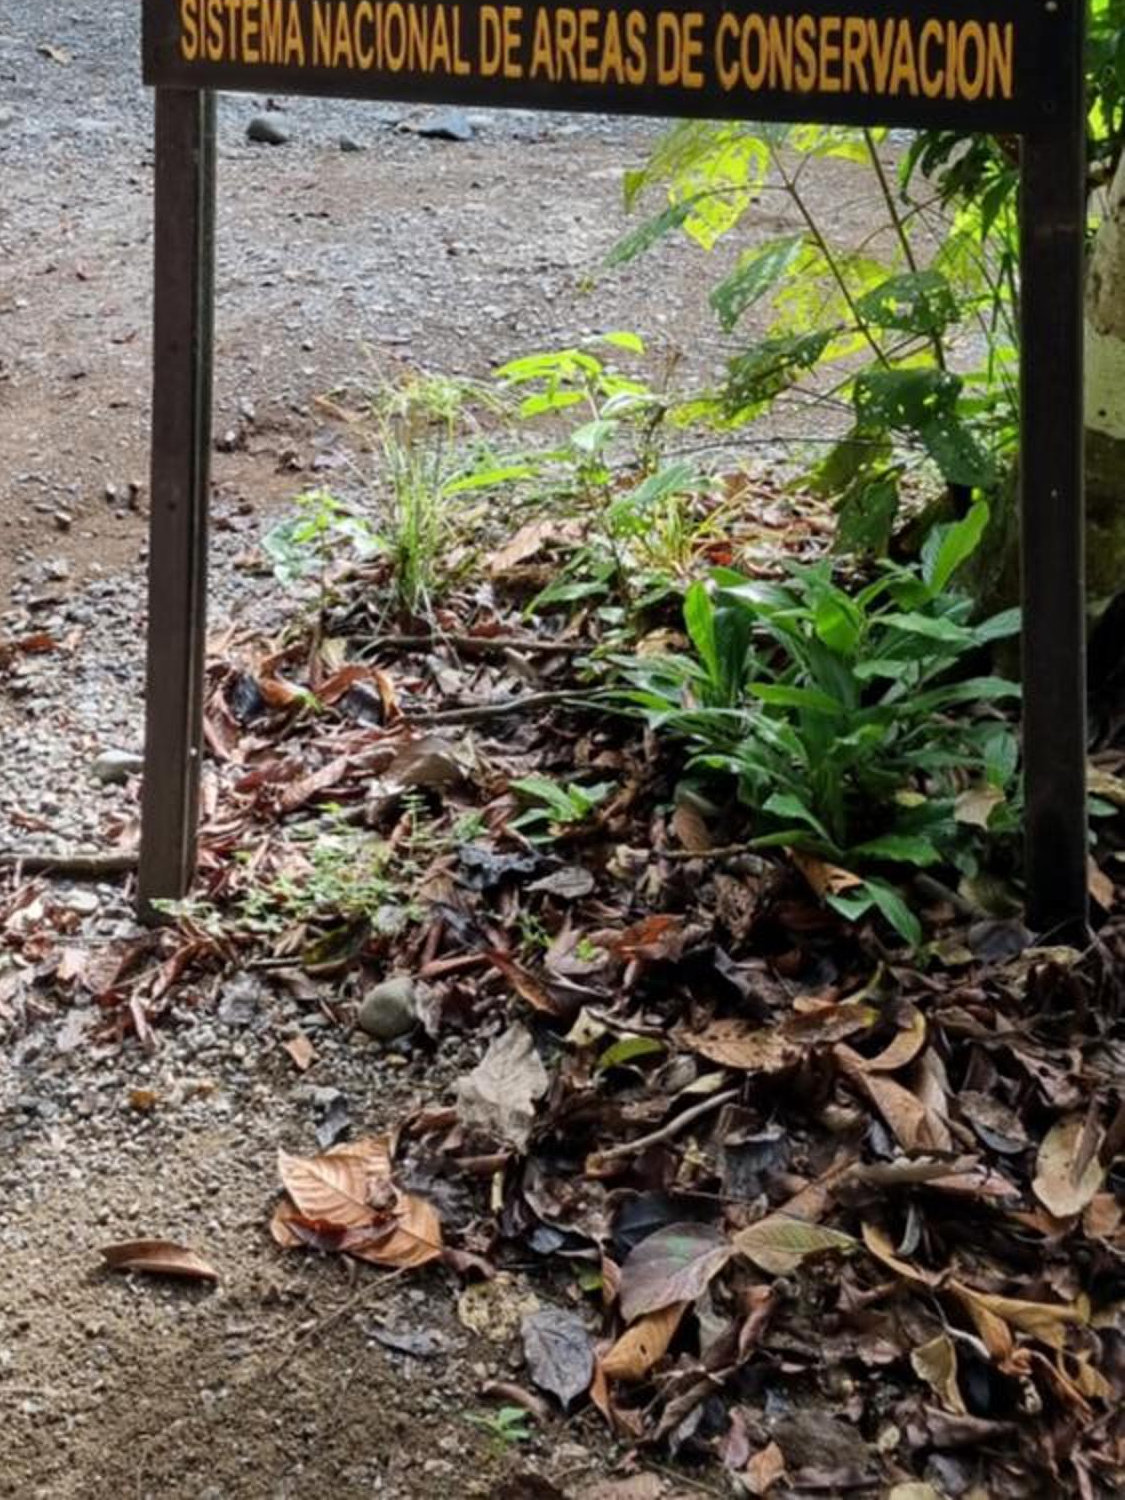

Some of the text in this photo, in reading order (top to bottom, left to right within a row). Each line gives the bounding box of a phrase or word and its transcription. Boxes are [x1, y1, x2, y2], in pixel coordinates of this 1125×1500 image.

[312, 0, 471, 74] NACIONAL
[480, 5, 523, 77] DE
[531, 8, 647, 84] AREAS
[657, 12, 703, 88] DE
[716, 13, 1012, 100] CONSERVACION
